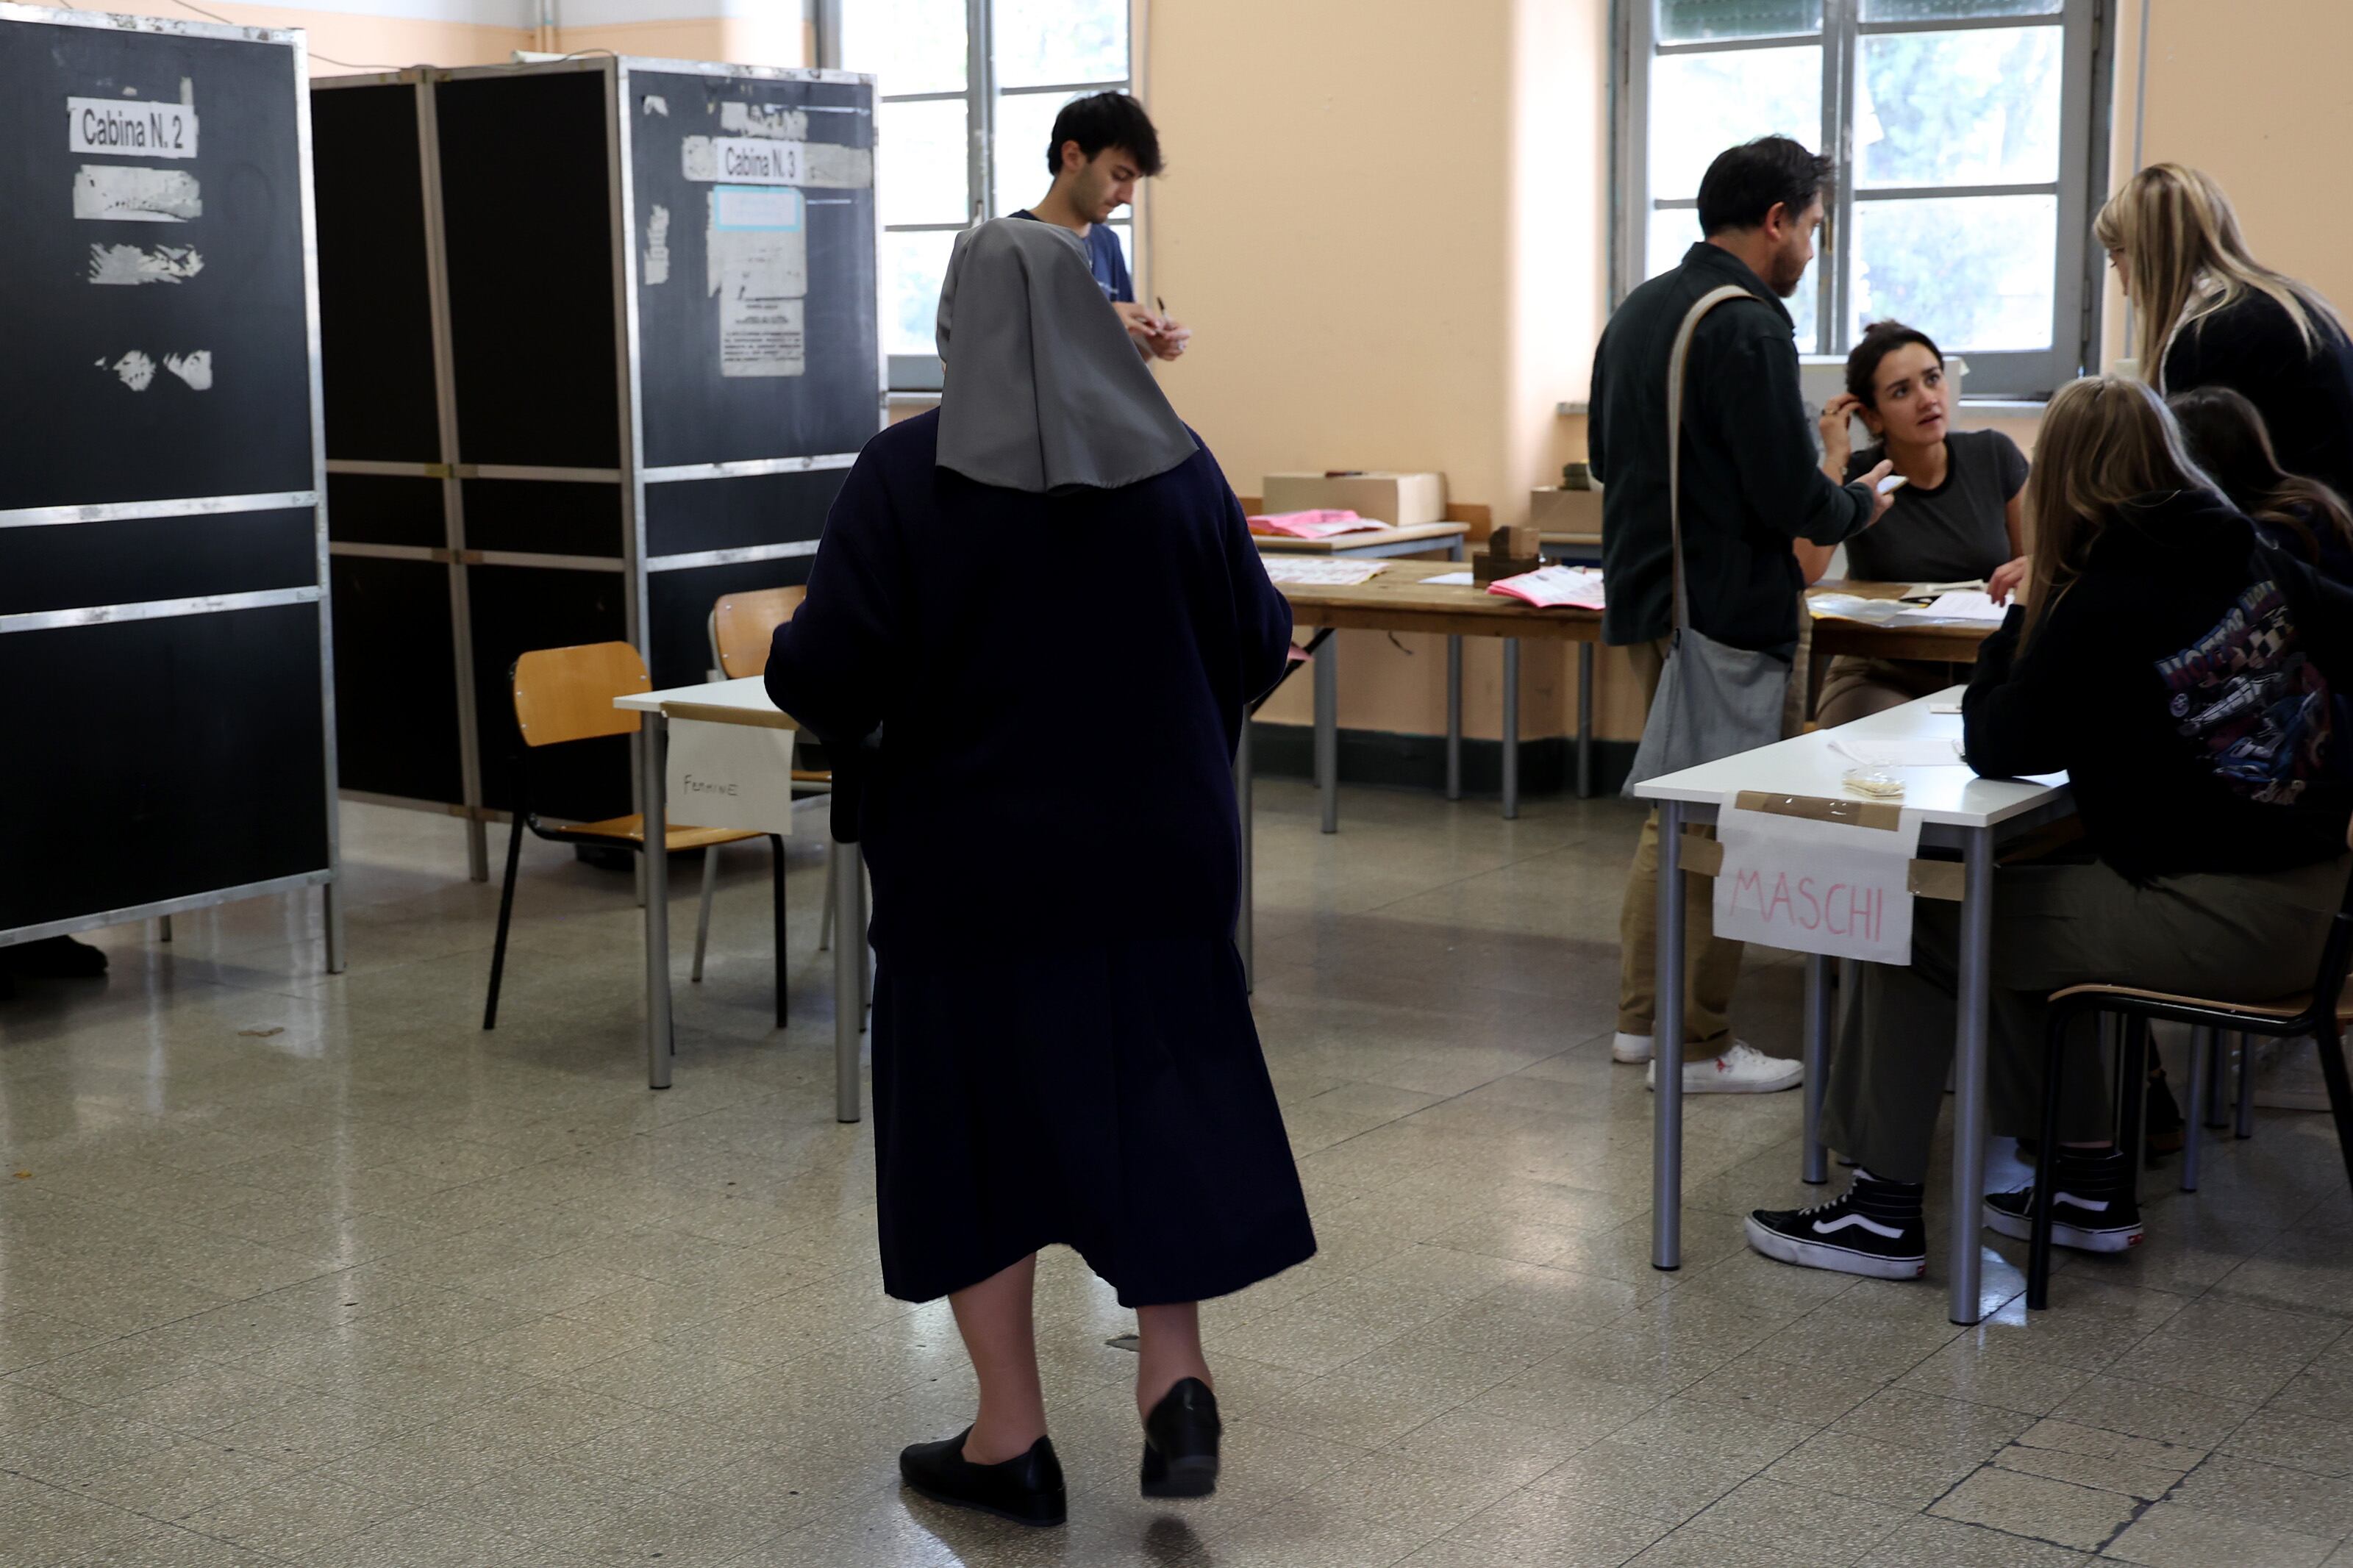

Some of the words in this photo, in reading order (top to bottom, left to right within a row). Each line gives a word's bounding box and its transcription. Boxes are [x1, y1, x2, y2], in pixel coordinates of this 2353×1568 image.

[82, 108, 146, 147] Cabina
[150, 112, 168, 148] N.
[172, 115, 184, 149] 2
[725, 146, 769, 176] Cabina
[788, 150, 796, 179] 3
[1729, 868, 1883, 942] MASCHI
